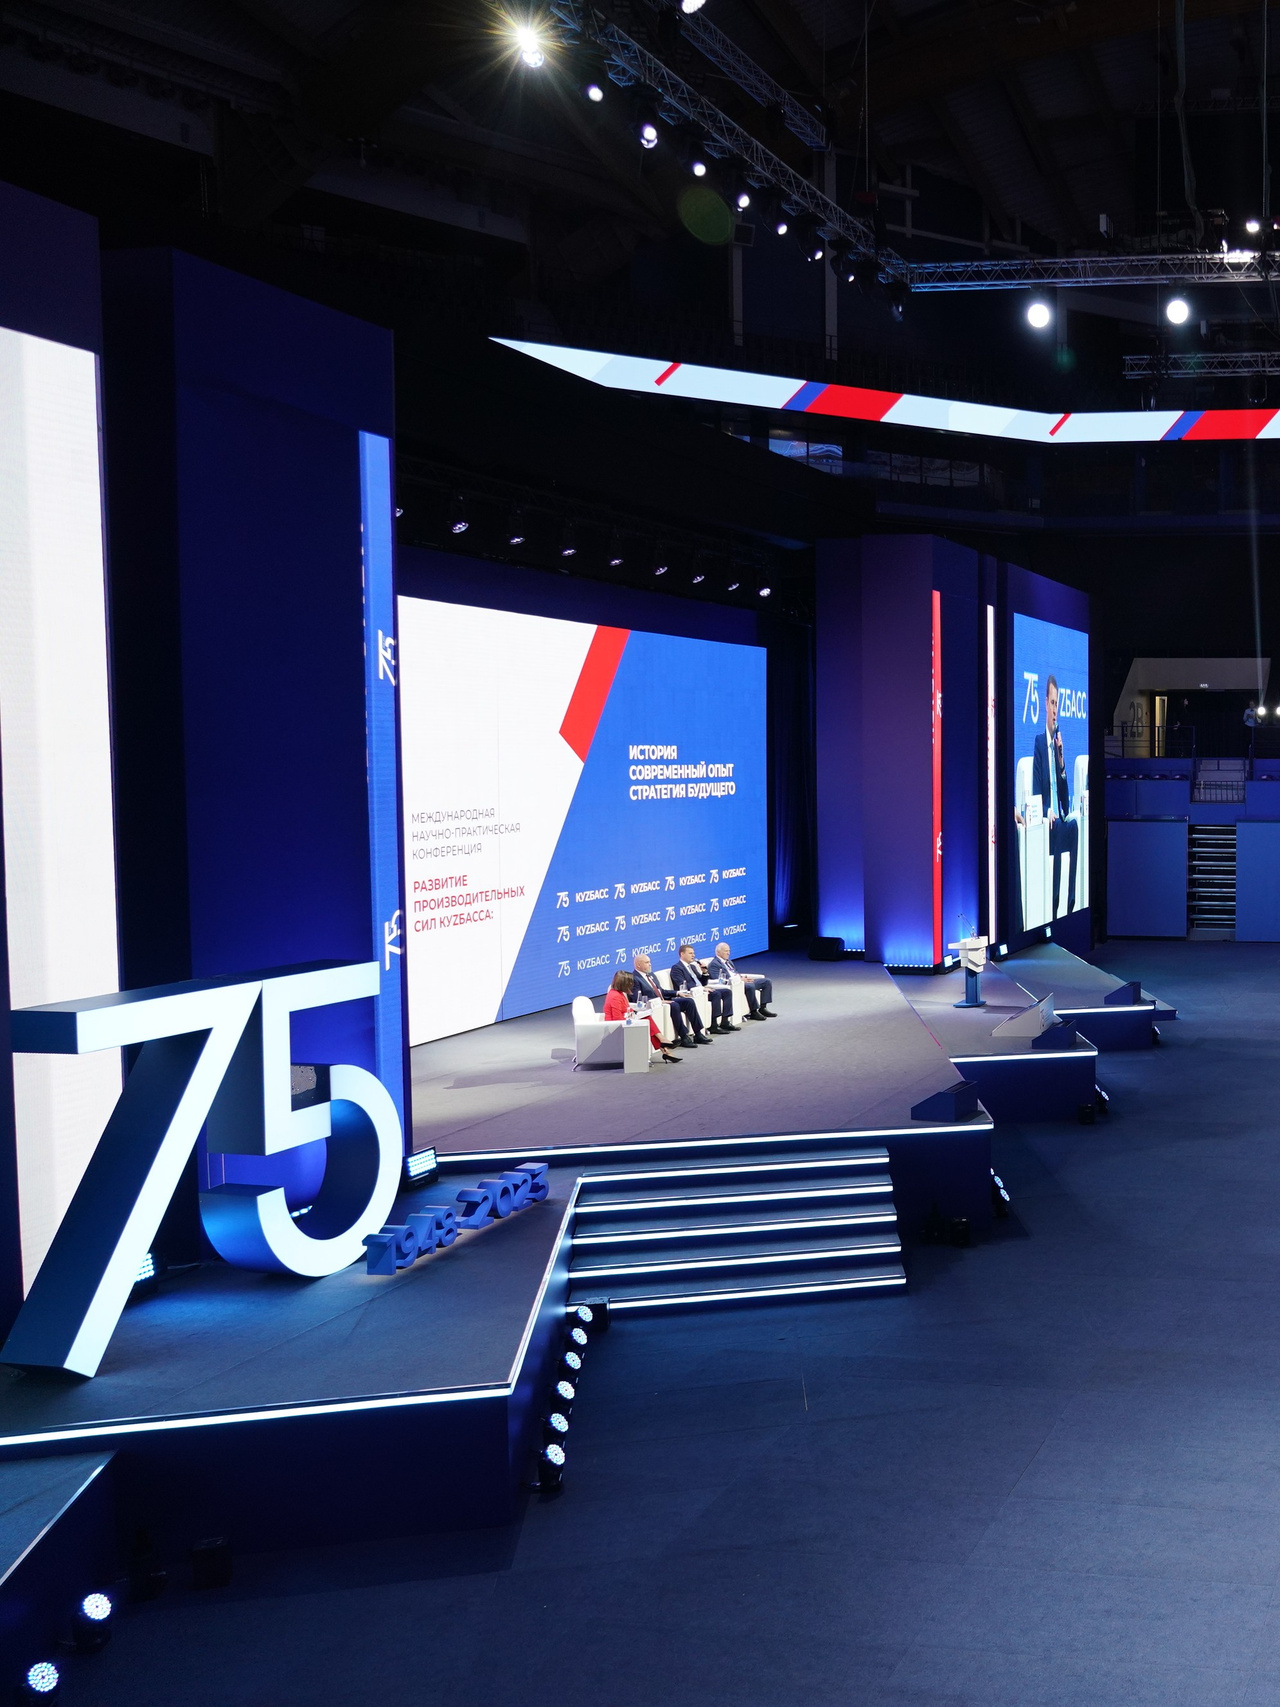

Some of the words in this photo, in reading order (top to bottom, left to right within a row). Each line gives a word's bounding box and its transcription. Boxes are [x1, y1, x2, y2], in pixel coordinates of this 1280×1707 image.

[1022, 671, 1040, 724] 75
[629, 745, 677, 760] ИСТОРИЯ
[629, 761, 706, 780] СОВРЕМЕННЫЙ
[707, 763, 734, 778] ОПЫТ
[629, 783, 686, 801] СТРАТЕГИЯ
[687, 781, 736, 799] БУДУЩЕГО
[411, 808, 495, 824] МЕЖДУНАРОДНАЯ
[412, 822, 521, 842] НАУЧНО-ПРАКТИЧЕСКАЯ
[412, 842, 482, 860] КОНФЕРЕНЦИЯ
[413, 874, 468, 893] РАЗВИТИЕ
[556, 891, 570, 909] 75
[575, 888, 609, 903] КУZБАСС
[614, 883, 626, 900] 75
[630, 880, 661, 894] КУZБАСС
[664, 875, 676, 892] 75
[679, 873, 706, 886] КУZБАСС
[709, 868, 720, 884] 75
[722, 866, 747, 879] КУZБАСС
[413, 885, 525, 913] ПРОИЗВОДИТЕЛЬНЫХ
[413, 917, 437, 933] СИЛ
[439, 908, 494, 929] КУZБАССА:
[557, 926, 571, 943] 75
[576, 920, 610, 936] КУZБАСС
[615, 915, 627, 932] 75
[631, 911, 661, 926] КУZБАСС
[665, 906, 676, 922] 75
[679, 902, 707, 916] КУZБАСС
[710, 897, 720, 913] 75
[722, 894, 747, 907] КУZБАСС
[557, 960, 571, 978] 75
[577, 954, 611, 971] КУZБАСС
[615, 948, 627, 965] 75
[666, 937, 677, 953] 75
[710, 927, 720, 942] 75
[723, 922, 747, 936] КУZБАСС
[63, 960, 402, 1378] 75
[362, 1163, 549, 1276] 1948-2023
